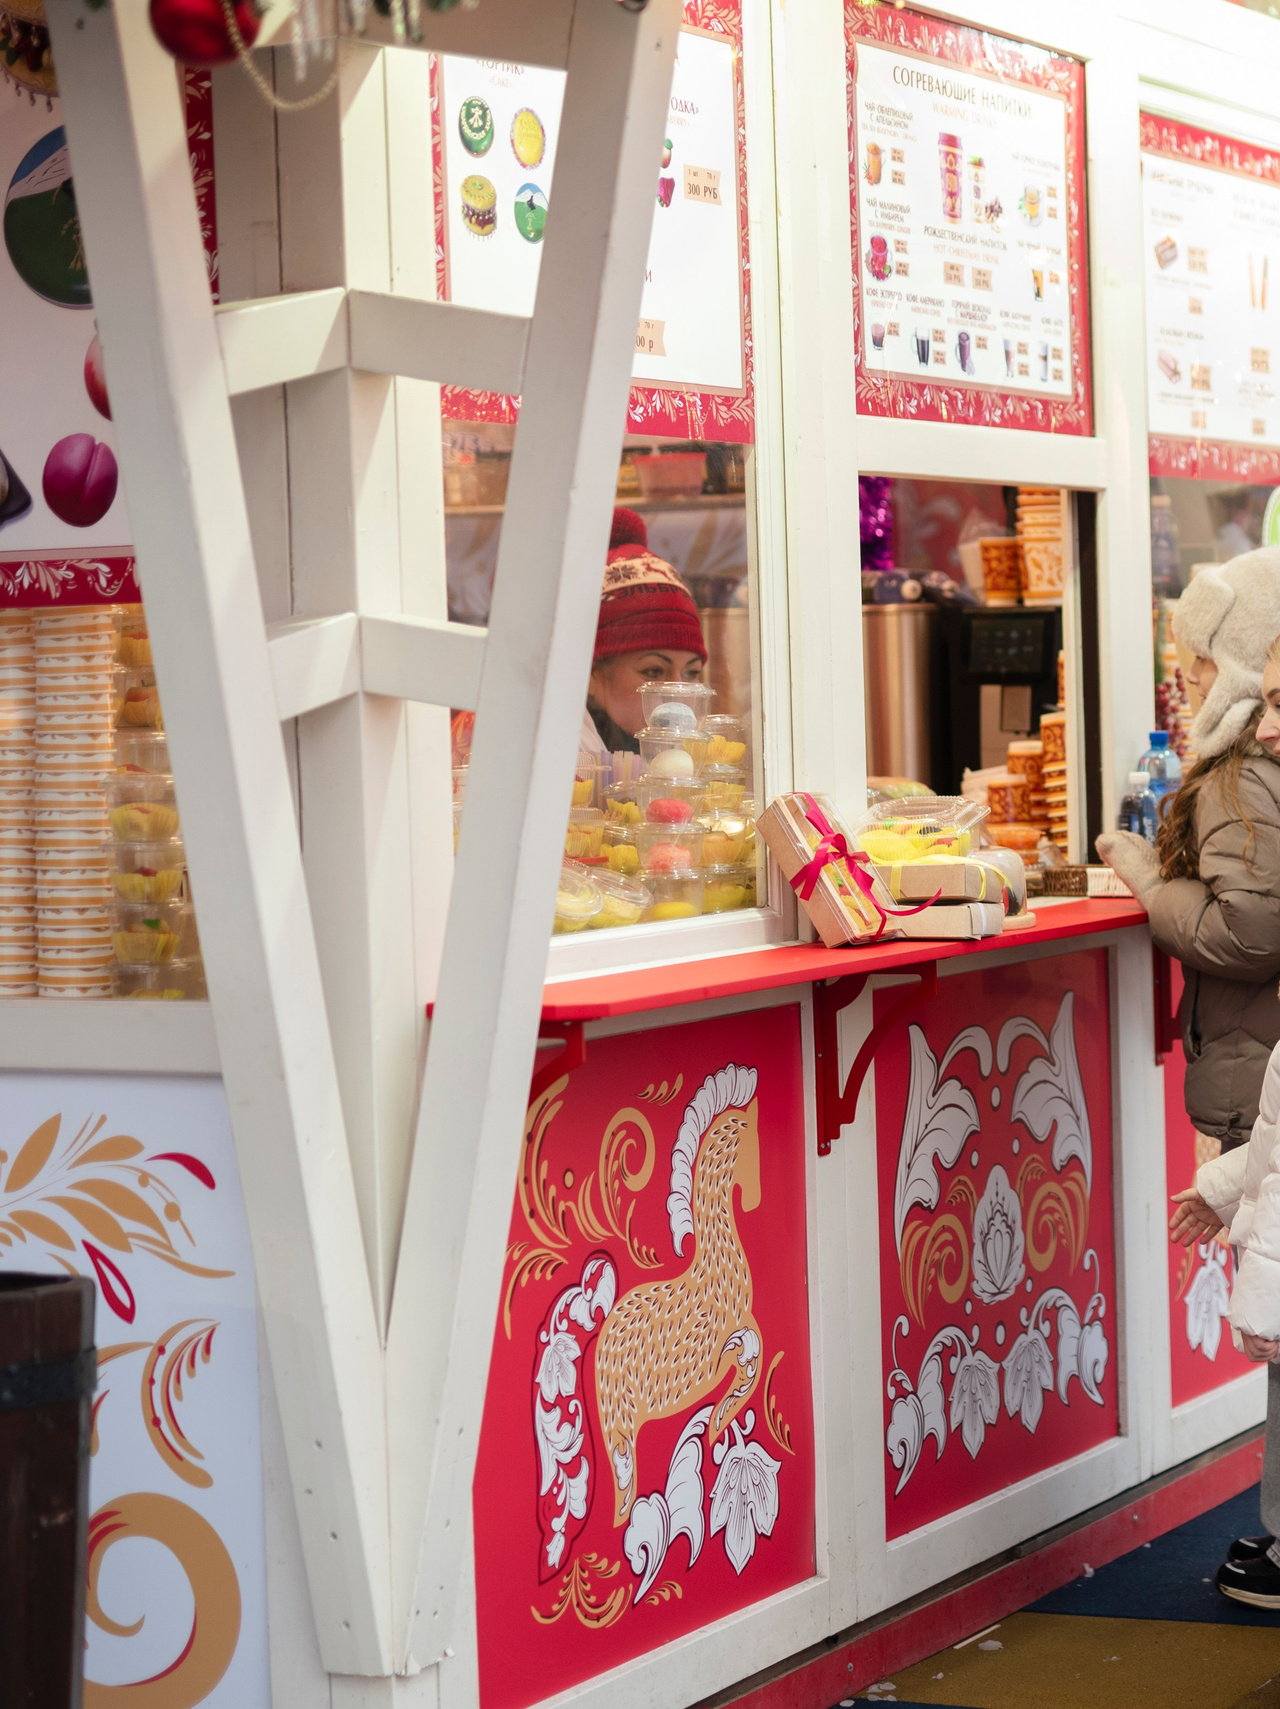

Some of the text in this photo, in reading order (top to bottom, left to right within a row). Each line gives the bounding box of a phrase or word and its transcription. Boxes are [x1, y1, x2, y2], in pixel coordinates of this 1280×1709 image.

[893, 65, 1032, 120] СОГРЕВАЮЩИЕ НАПИТКИ
[670, 96, 699, 115] ОДКА»
[864, 101, 876, 111] ЧАЙ
[706, 171, 713, 181] 70
[687, 182, 718, 199] 300 РУБ
[866, 197, 877, 208] ЧАЙ
[924, 225, 977, 244] РОЖДЕСТВЕНСКИЙ
[933, 243, 946, 254] HOT
[636, 335, 645, 347] 00
